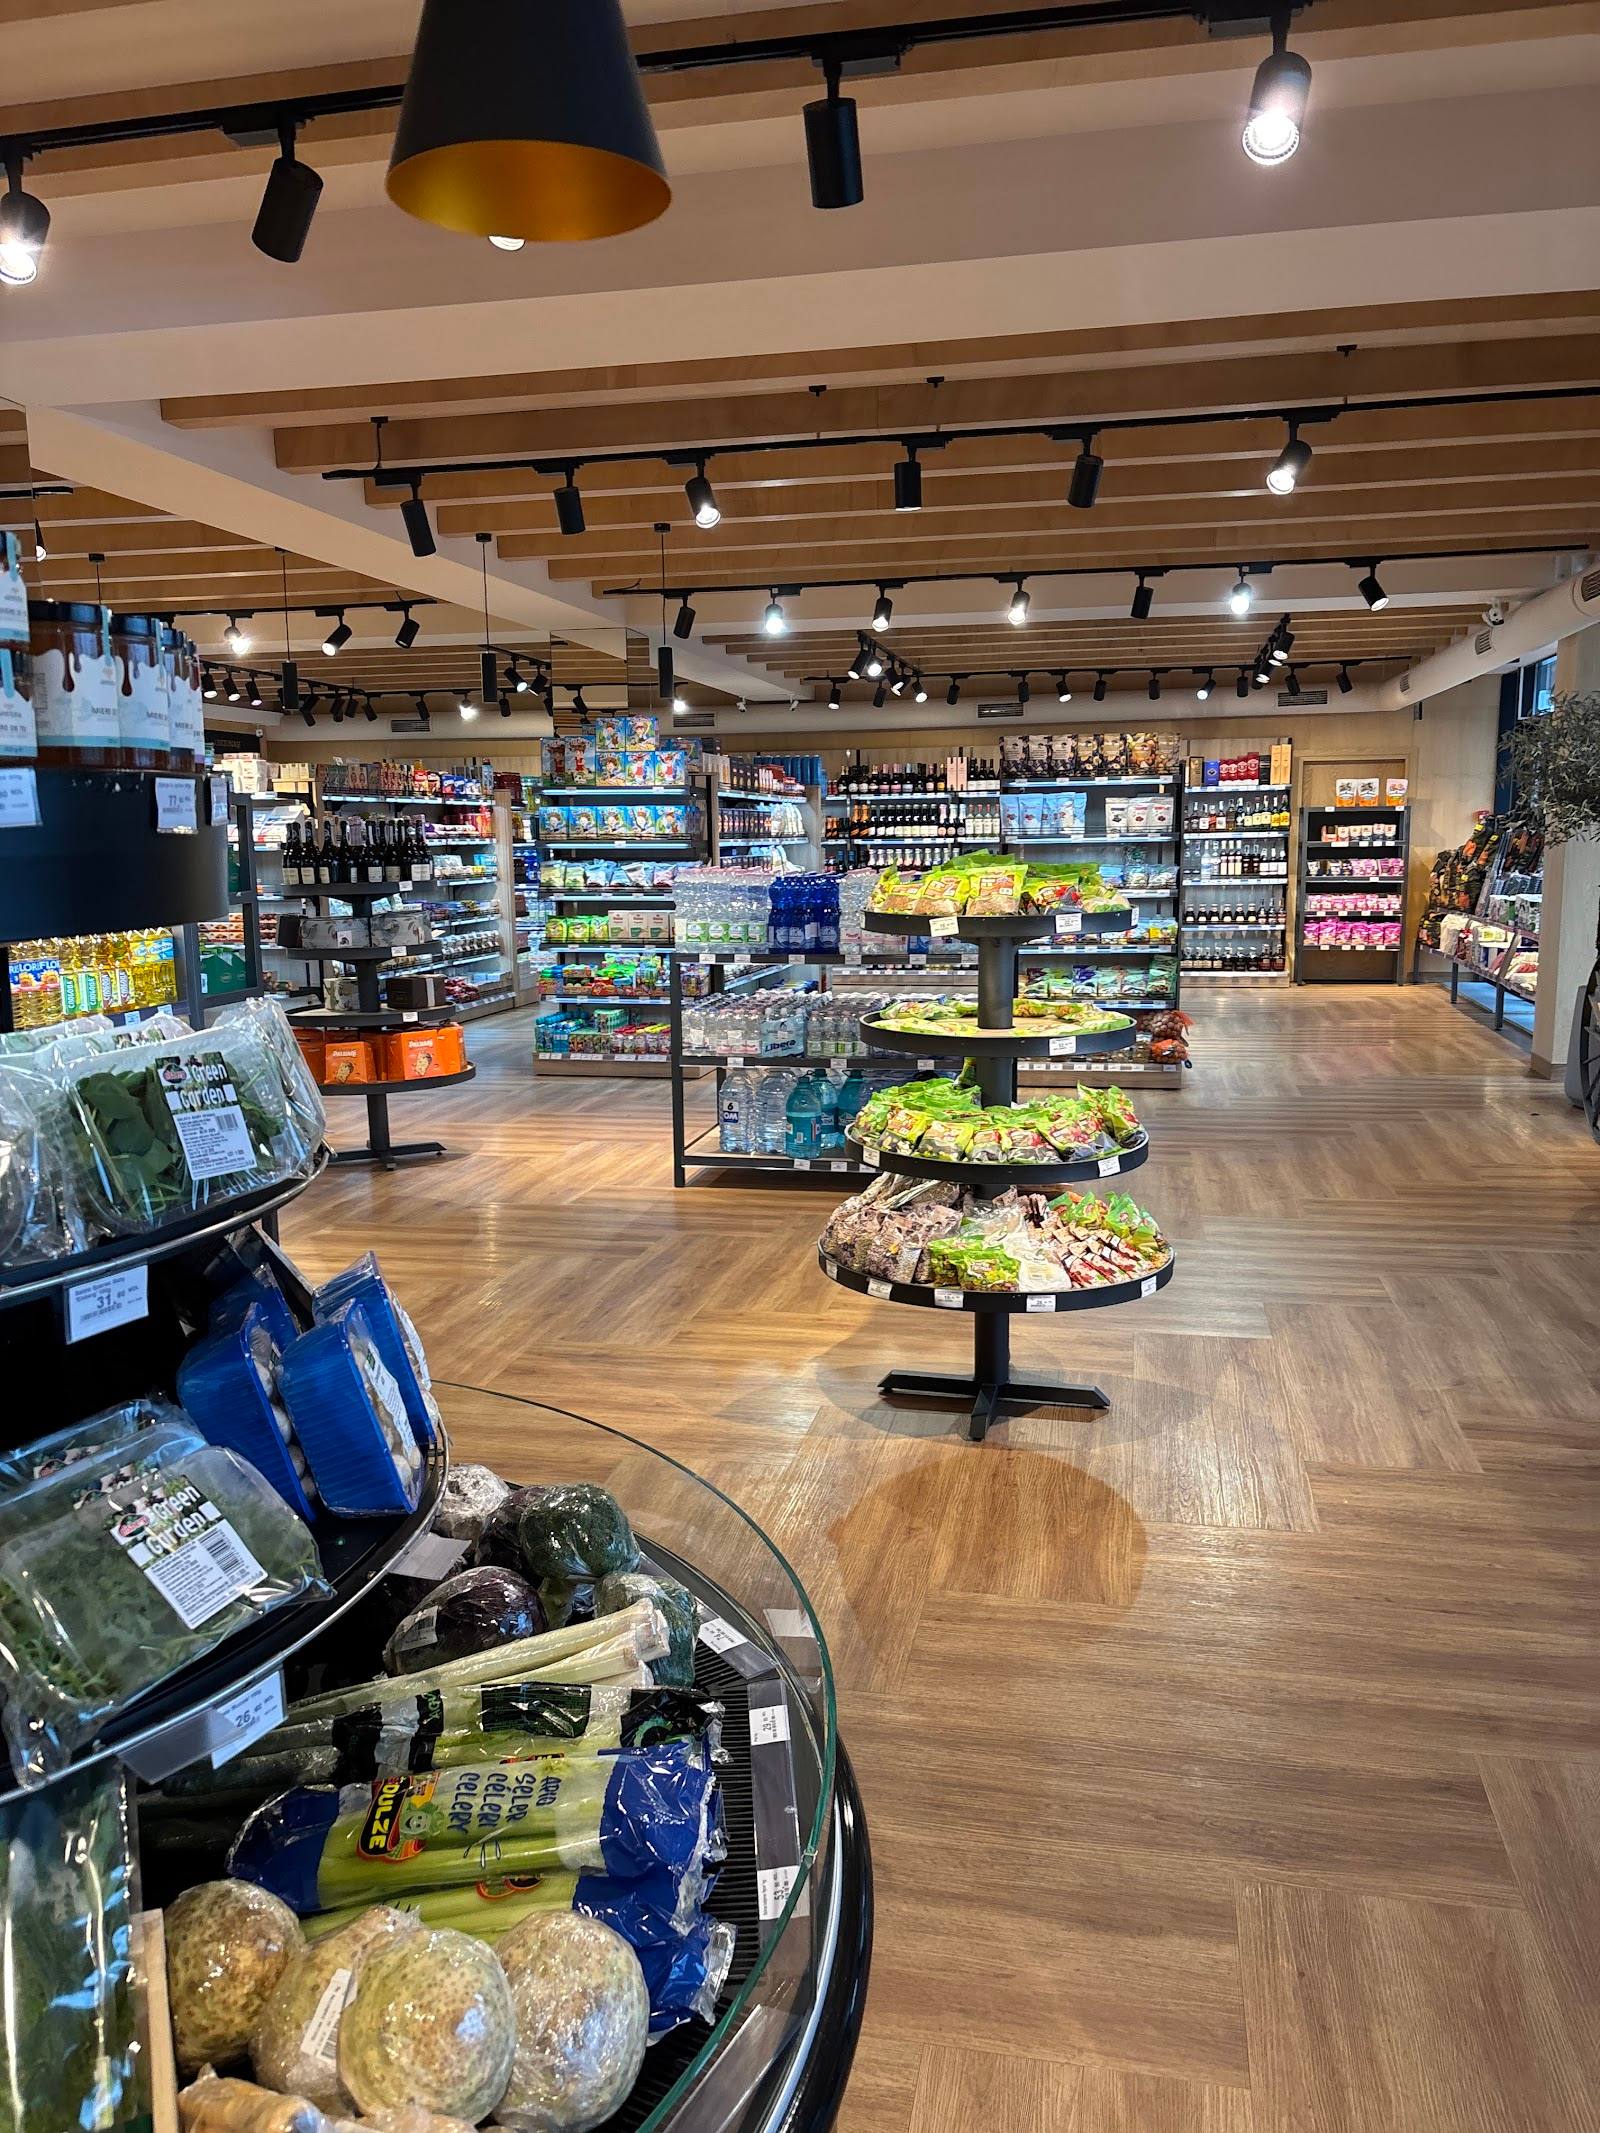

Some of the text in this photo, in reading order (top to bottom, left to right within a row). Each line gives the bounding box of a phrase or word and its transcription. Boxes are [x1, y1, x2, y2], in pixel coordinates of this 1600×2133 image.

[764, 1039, 797, 1053] Libera
[191, 1063, 228, 1083] Green
[179, 1087, 226, 1110] Garden
[152, 1485, 201, 1520] Green
[145, 1511, 207, 1556] Garden
[536, 1774, 562, 1808] APIO
[368, 1784, 401, 1850] DULZE
